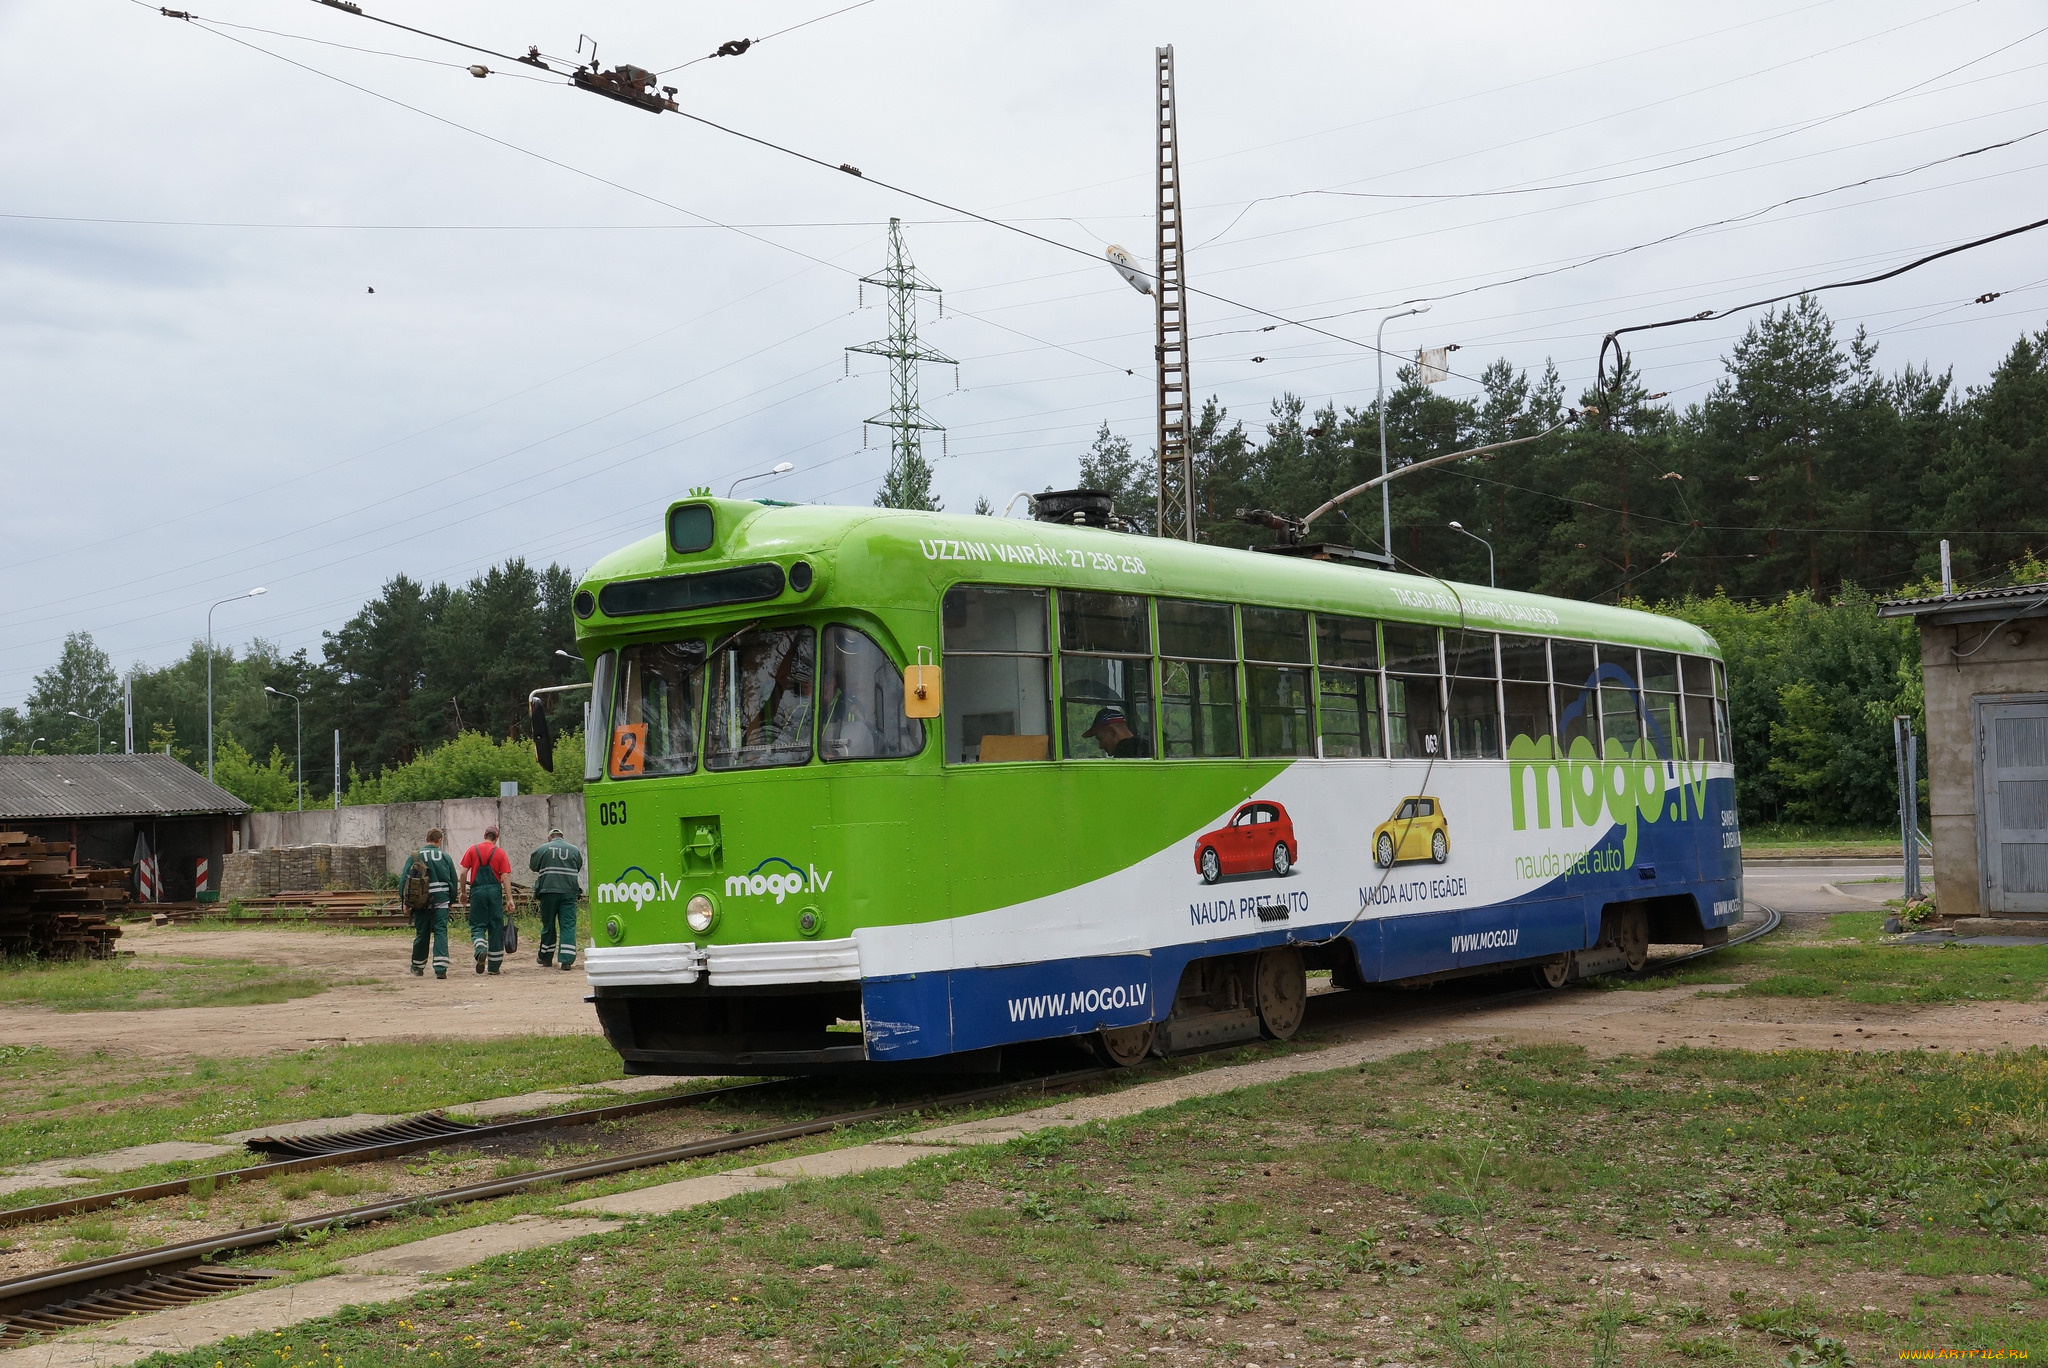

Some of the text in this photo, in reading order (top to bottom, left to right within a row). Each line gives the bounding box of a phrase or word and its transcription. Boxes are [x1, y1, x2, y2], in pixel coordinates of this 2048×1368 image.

[919, 539, 1147, 575] UZZINI VAIRĀK: 27 258 258
[1389, 586, 1432, 609] TAGAD
[618, 732, 637, 772] 2
[1506, 702, 1708, 871] mogo.lv
[599, 800, 627, 827] 063
[420, 849, 443, 862] TU
[549, 846, 569, 861] TU
[1515, 842, 1622, 882] nauda pret auto
[597, 872, 682, 912] mogo.lv
[725, 863, 833, 905] mogo.lv
[1359, 875, 1468, 907] NAUDA AUTO IEGĀDEI
[1190, 900, 1236, 926] NAUDA
[1451, 928, 1519, 954] WWW.MOGO.LV
[1008, 982, 1147, 1023] WWW.MOGO.LV
